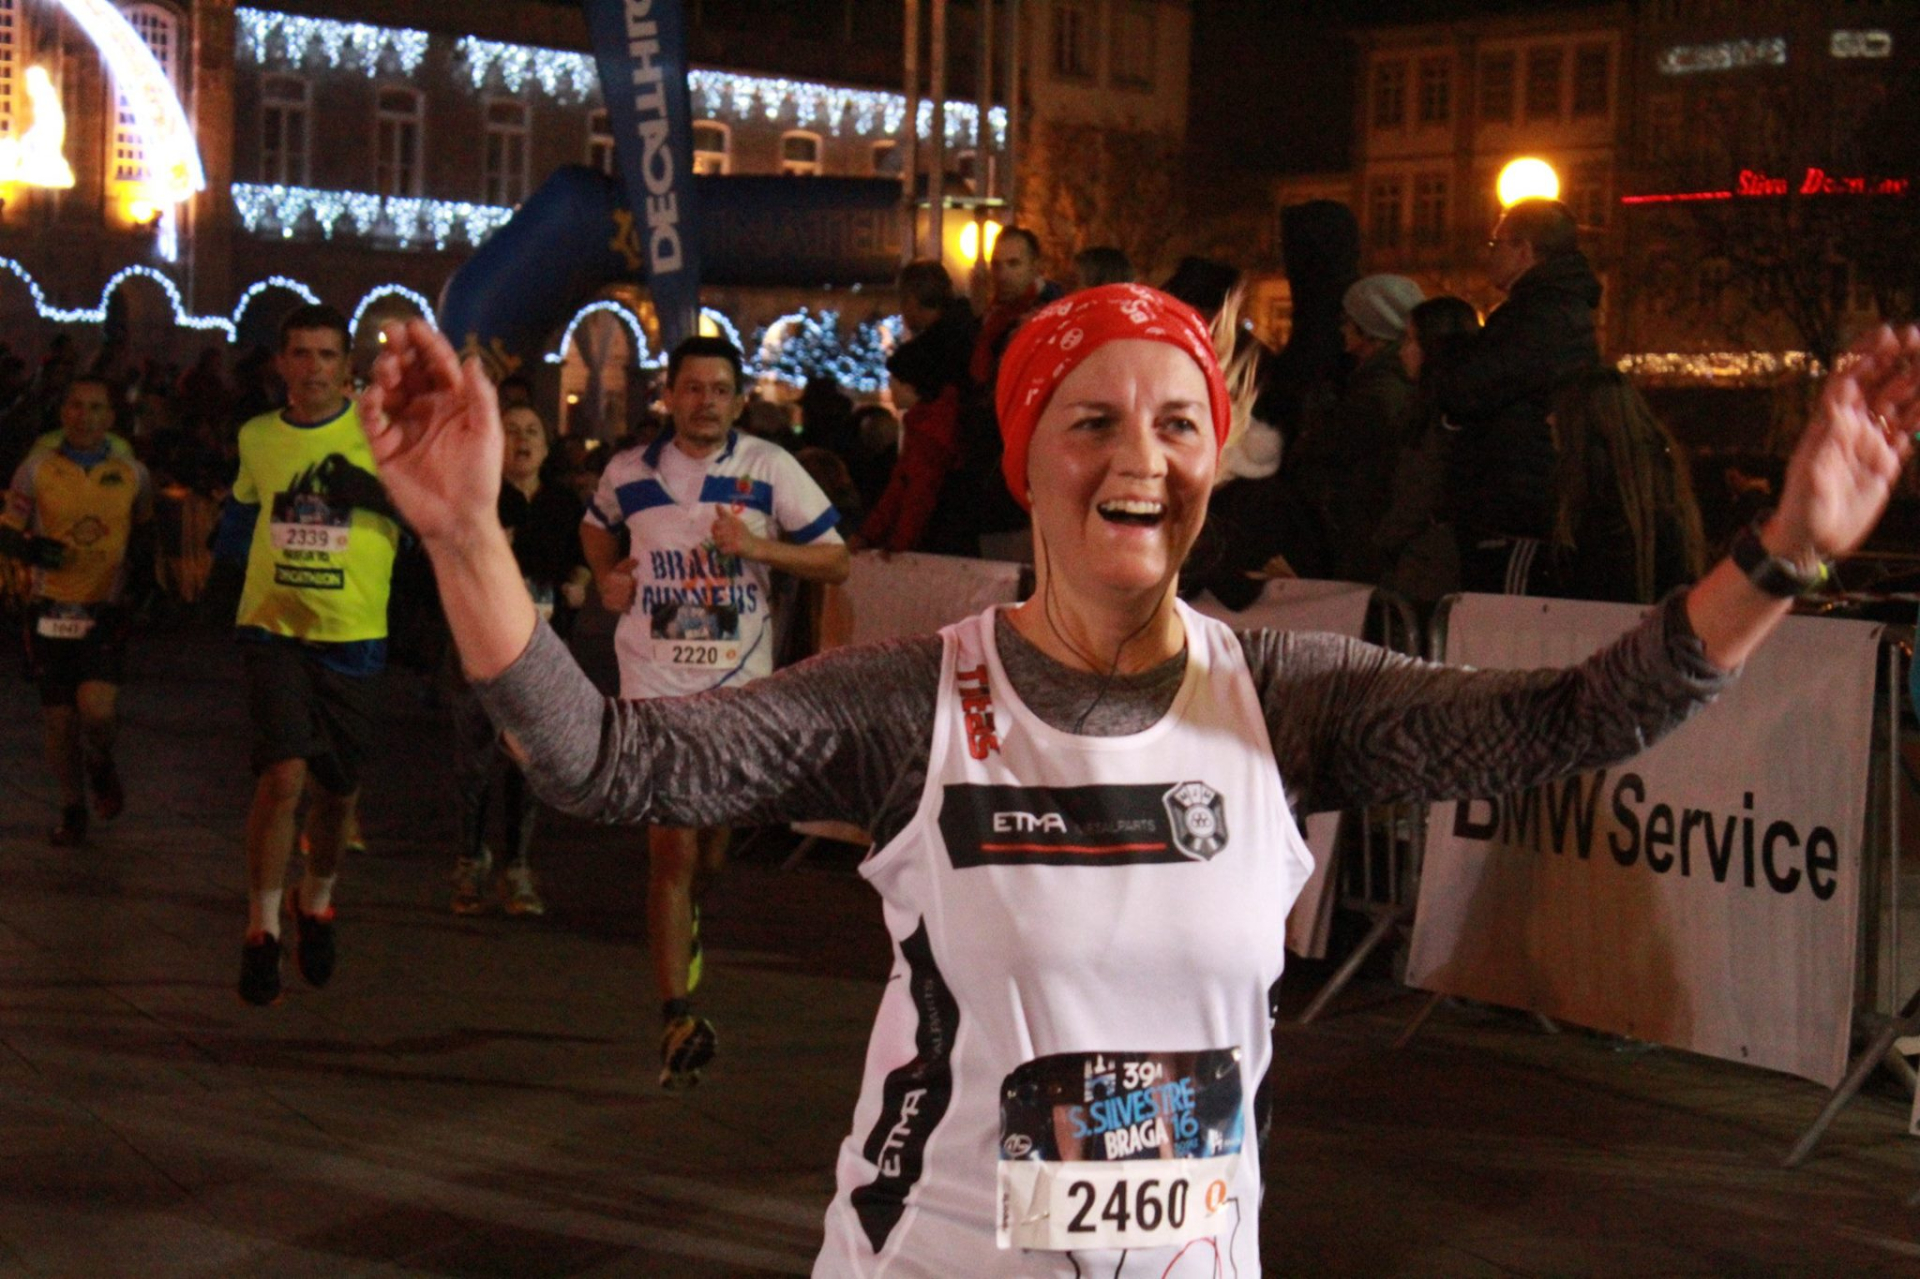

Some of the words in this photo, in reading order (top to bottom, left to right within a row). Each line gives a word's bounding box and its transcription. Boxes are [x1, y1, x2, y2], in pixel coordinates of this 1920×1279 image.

[286, 528, 330, 547] 2339
[672, 645, 719, 665] 2220
[992, 811, 1068, 834] ETMA
[1607, 772, 1839, 901] Service
[877, 1088, 927, 1178] ETMA
[1104, 1116, 1170, 1161] BRAGA
[1171, 1109, 1200, 1141] 16
[1066, 1177, 1189, 1233] 2460
